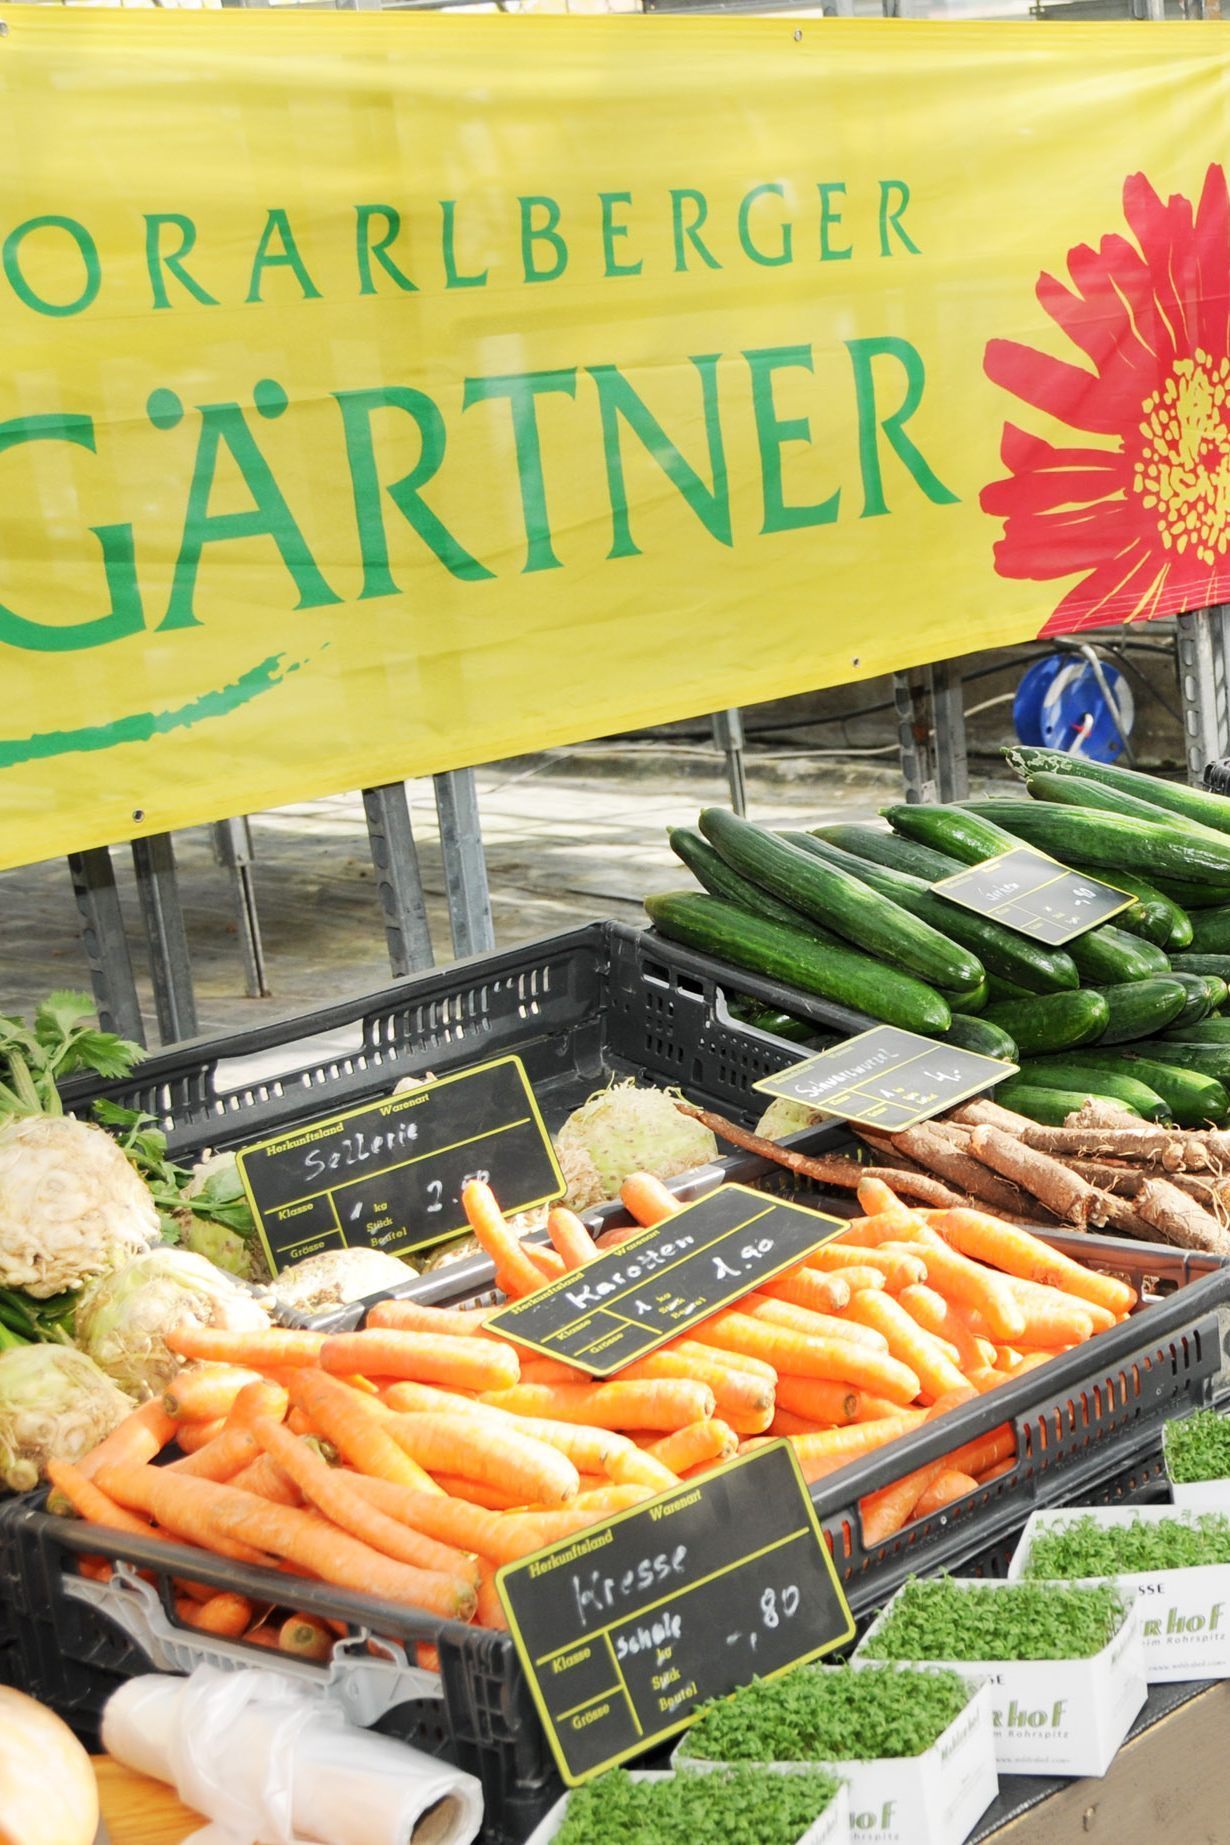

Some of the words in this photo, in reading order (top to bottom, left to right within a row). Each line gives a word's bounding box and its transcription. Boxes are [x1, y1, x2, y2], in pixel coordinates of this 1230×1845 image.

[3, 179, 923, 318] ORARLBERGER
[0, 334, 962, 653] GÄRTNER
[266, 1122, 345, 1157] Herkunftsland
[380, 1094, 430, 1117] Warenart
[278, 1201, 314, 1222] Klasse
[290, 1240, 325, 1259] Grösse
[510, 1271, 585, 1316] Herkunftsland
[613, 1229, 661, 1257] Warenart
[565, 1235, 695, 1310] Karotten
[556, 1319, 592, 1341] Klasse
[590, 1332, 624, 1354] Grösse
[529, 1528, 614, 1580] Herkunftsland
[649, 1489, 702, 1521] Warenart
[572, 1544, 688, 1627] Kresse
[552, 1647, 592, 1674] Klasse
[1166, 1633, 1226, 1646] Rohrspitz
[571, 1703, 611, 1730] Grösse
